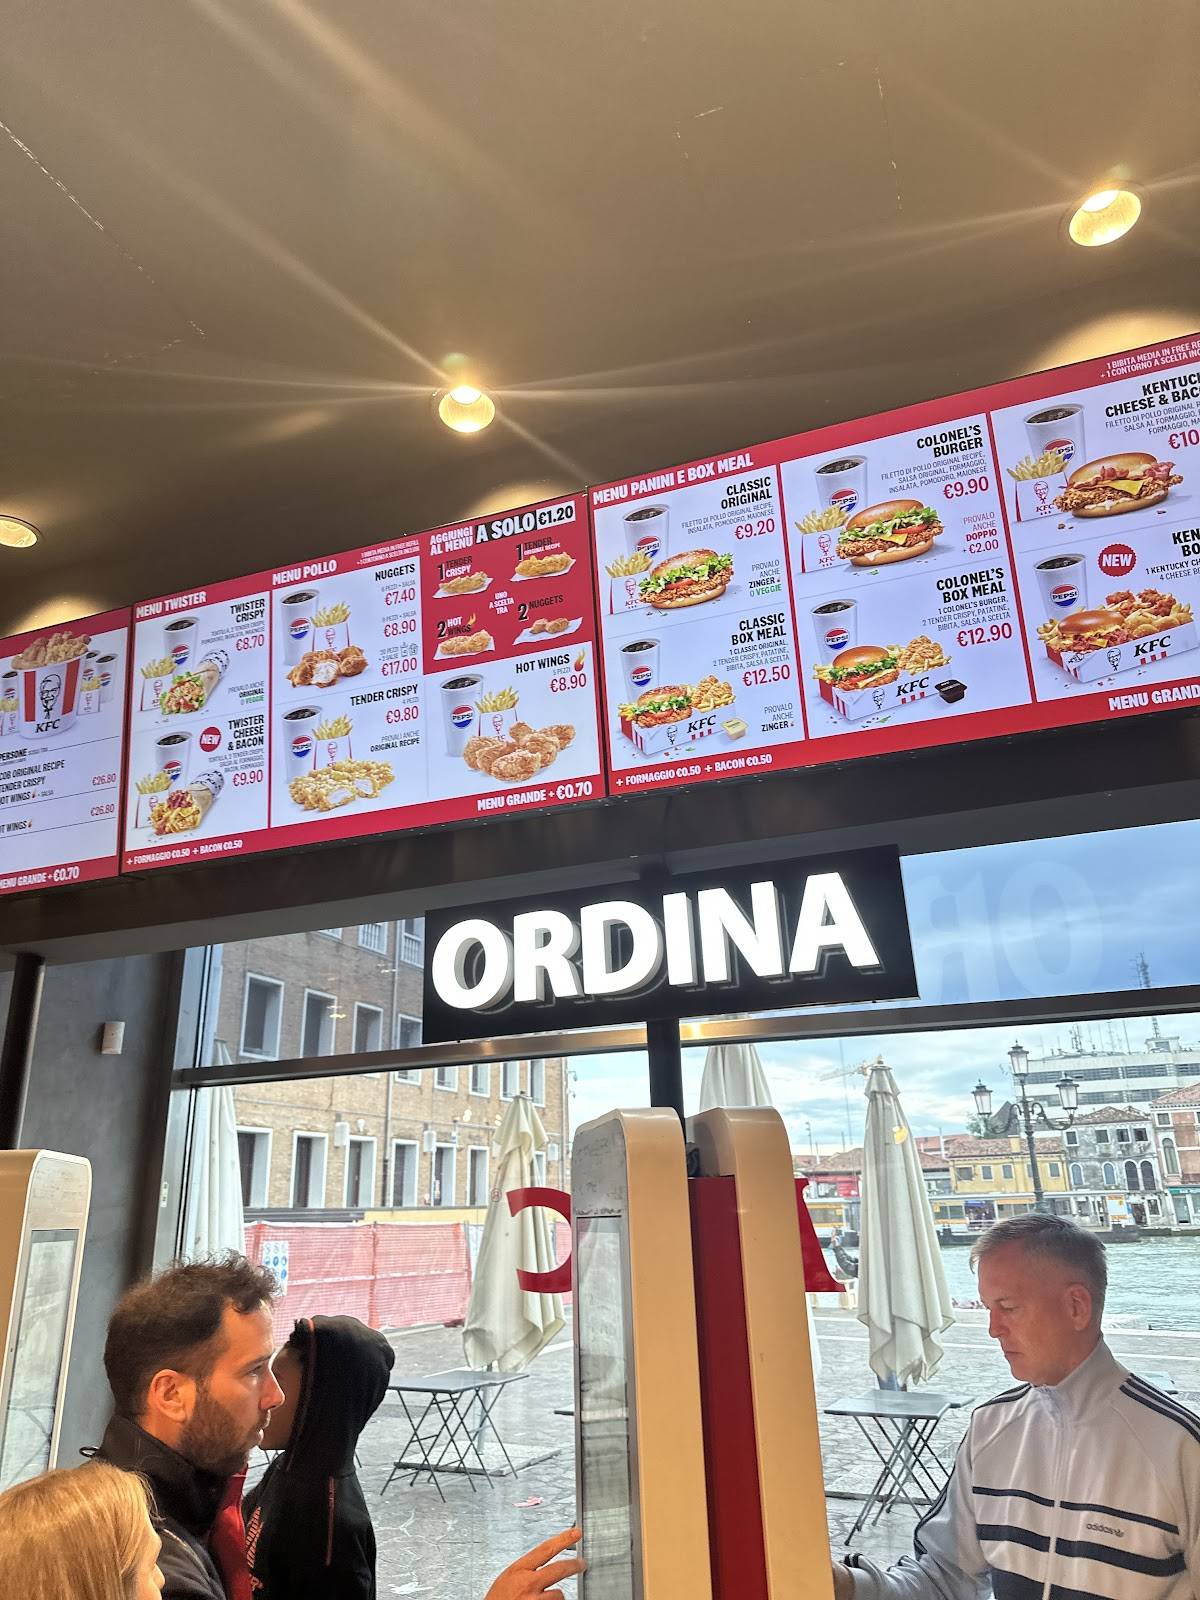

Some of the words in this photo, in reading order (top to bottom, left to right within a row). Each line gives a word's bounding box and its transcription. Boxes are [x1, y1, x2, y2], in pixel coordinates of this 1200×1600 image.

[1111, 360, 1153, 376] CONTORNO
[1154, 358, 1160, 367] A
[1160, 351, 1189, 365] SCELTA
[1112, 356, 1136, 368] BIBITA
[1137, 350, 1161, 362] MEDIA
[1162, 348, 1170, 356] IN
[1171, 343, 1190, 355] FREE
[1105, 396, 1156, 417] CHEESE
[1158, 394, 1169, 405] &
[1106, 417, 1131, 429] FILETTO
[1141, 410, 1162, 421] POLLO
[1163, 403, 1194, 416] ORIGINAL
[1124, 423, 1145, 433] SALSA
[1146, 419, 1155, 428] AL
[1156, 411, 1197, 426] FORMAGGIO,
[916, 424, 982, 449] COLONEL'S
[1149, 420, 1189, 435] FORMAGGIO,
[933, 437, 983, 458] BURGER
[881, 469, 905, 480] FILETTO
[905, 468, 912, 476] DI
[913, 464, 932, 475] POLLO
[932, 457, 961, 470] ORIGINAL
[898, 474, 918, 483] SALSA
[918, 467, 949, 480] ORIGINAL,
[949, 459, 987, 473] FORMAGGIO,
[593, 484, 628, 505] MENU
[630, 471, 674, 496] PANINI
[677, 471, 685, 483] E
[687, 463, 715, 480] BOX
[717, 453, 754, 474] MEAL
[726, 476, 771, 496] CLASSIC
[889, 483, 920, 494] INSALATA,
[920, 475, 956, 488] POMODORO,
[956, 466, 988, 480] MAIONESE
[943, 476, 989, 500] €9.90
[721, 488, 773, 510] ORIGINAL
[476, 524, 489, 544] A
[491, 512, 535, 540] SOLO
[538, 505, 573, 526] €1.20
[681, 517, 703, 529] FILETTO
[703, 516, 709, 524] DI
[709, 512, 727, 523] POLLO
[727, 506, 752, 519] ORIGINAL
[715, 516, 746, 529] POMODORO,
[747, 508, 775, 521] MAIONESE
[963, 512, 995, 525] PROVALO
[972, 521, 996, 531] ANCHE
[430, 526, 474, 546] AGGIUNGI
[734, 518, 776, 540] €9.20
[966, 529, 998, 542] DOPPIO
[1172, 528, 1200, 545] KEN
[430, 544, 443, 556] AL
[444, 535, 473, 553] MENU
[968, 539, 999, 554] €2.00
[446, 555, 473, 569] TENDER
[751, 559, 780, 572] PROVALO
[818, 555, 836, 565] KFC
[1102, 553, 1132, 567] NEW
[1151, 560, 1189, 574] KENTUCKY
[272, 568, 302, 586] MENU
[302, 559, 338, 579] POLLO
[375, 563, 415, 581] NUGGETS
[445, 564, 472, 578] CRISPY
[759, 568, 781, 579] ANCHE
[936, 567, 1004, 591] COLONEL'S
[1165, 569, 1191, 580] CHEESE
[749, 577, 775, 589] ZINGER
[756, 584, 782, 596] VEGGIE
[384, 587, 416, 606] €7.40
[943, 586, 968, 604] BOX
[972, 581, 1006, 598] MEAL
[1052, 591, 1078, 600] PEPSI
[136, 602, 163, 619] MENU
[164, 591, 207, 611] TWISTER
[230, 598, 265, 614] TWISTER
[496, 606, 508, 615] TRA
[529, 594, 564, 610] NUGGETS
[943, 600, 978, 615] COLONEL'S
[236, 608, 265, 623] CRISPY
[447, 616, 463, 626] HOT
[517, 603, 529, 622] 2
[739, 612, 785, 631] CLASSIC
[928, 614, 952, 626] TENDER
[977, 603, 1010, 616] PATATINE,
[960, 617, 980, 628] SALSA
[980, 616, 987, 624] A
[987, 611, 1011, 623] SCELTA
[384, 619, 417, 637] €8.90
[437, 620, 448, 639] 2
[731, 631, 754, 646] BOX
[756, 625, 787, 641] MEAL
[956, 622, 1013, 647] €12.90
[235, 634, 265, 651] €8.70
[825, 633, 849, 643] PEPSI
[1134, 635, 1171, 657] KFC
[733, 645, 758, 656] CLASSIC
[381, 657, 418, 676] €17.00
[515, 660, 536, 674] HOT
[537, 653, 570, 669] WINGS
[717, 655, 739, 666] TENDER
[746, 658, 763, 669] SALSA
[763, 657, 769, 665] A
[769, 654, 790, 665] SCELTA
[550, 673, 587, 693] €8.90
[742, 664, 791, 687] €12.50
[350, 690, 385, 707] TENDER
[386, 684, 419, 699] CRISPY
[896, 676, 930, 697] KFC
[1109, 691, 1148, 712] MENU
[1151, 684, 1200, 705] GRAND
[386, 705, 419, 724] €9.80
[764, 703, 793, 715] PROVALO
[772, 711, 794, 722] ANCHE
[35, 719, 61, 733] KFC
[228, 714, 264, 730] TWISTER
[687, 714, 717, 734] KFC
[761, 721, 789, 732] ZINGER
[200, 734, 221, 745] NEW
[233, 725, 264, 739] CHEESE
[228, 742, 234, 750] &
[235, 736, 264, 750] BACON
[12, 764, 42, 778] ORIGINAL
[43, 759, 66, 772] RECIPE
[625, 768, 675, 786] FORMAGGIO
[676, 764, 701, 778] €0.50
[714, 758, 746, 772] BACON
[746, 753, 773, 767] €0.50
[22, 776, 47, 788] CRISPY
[92, 773, 117, 786] €26.80
[233, 769, 264, 787] €9.90
[10, 791, 31, 803] WINGS
[477, 793, 506, 812] MENU
[506, 789, 547, 806] GRANDE
[556, 781, 593, 800] €0.70
[6, 820, 28, 832] WINGS
[133, 852, 172, 865] FORMAGGIO
[17, 872, 47, 886] GRANDE
[53, 866, 80, 882] €0.70
[432, 872, 880, 1009] ORDINA
[1086, 1523, 1114, 1535] adidas
